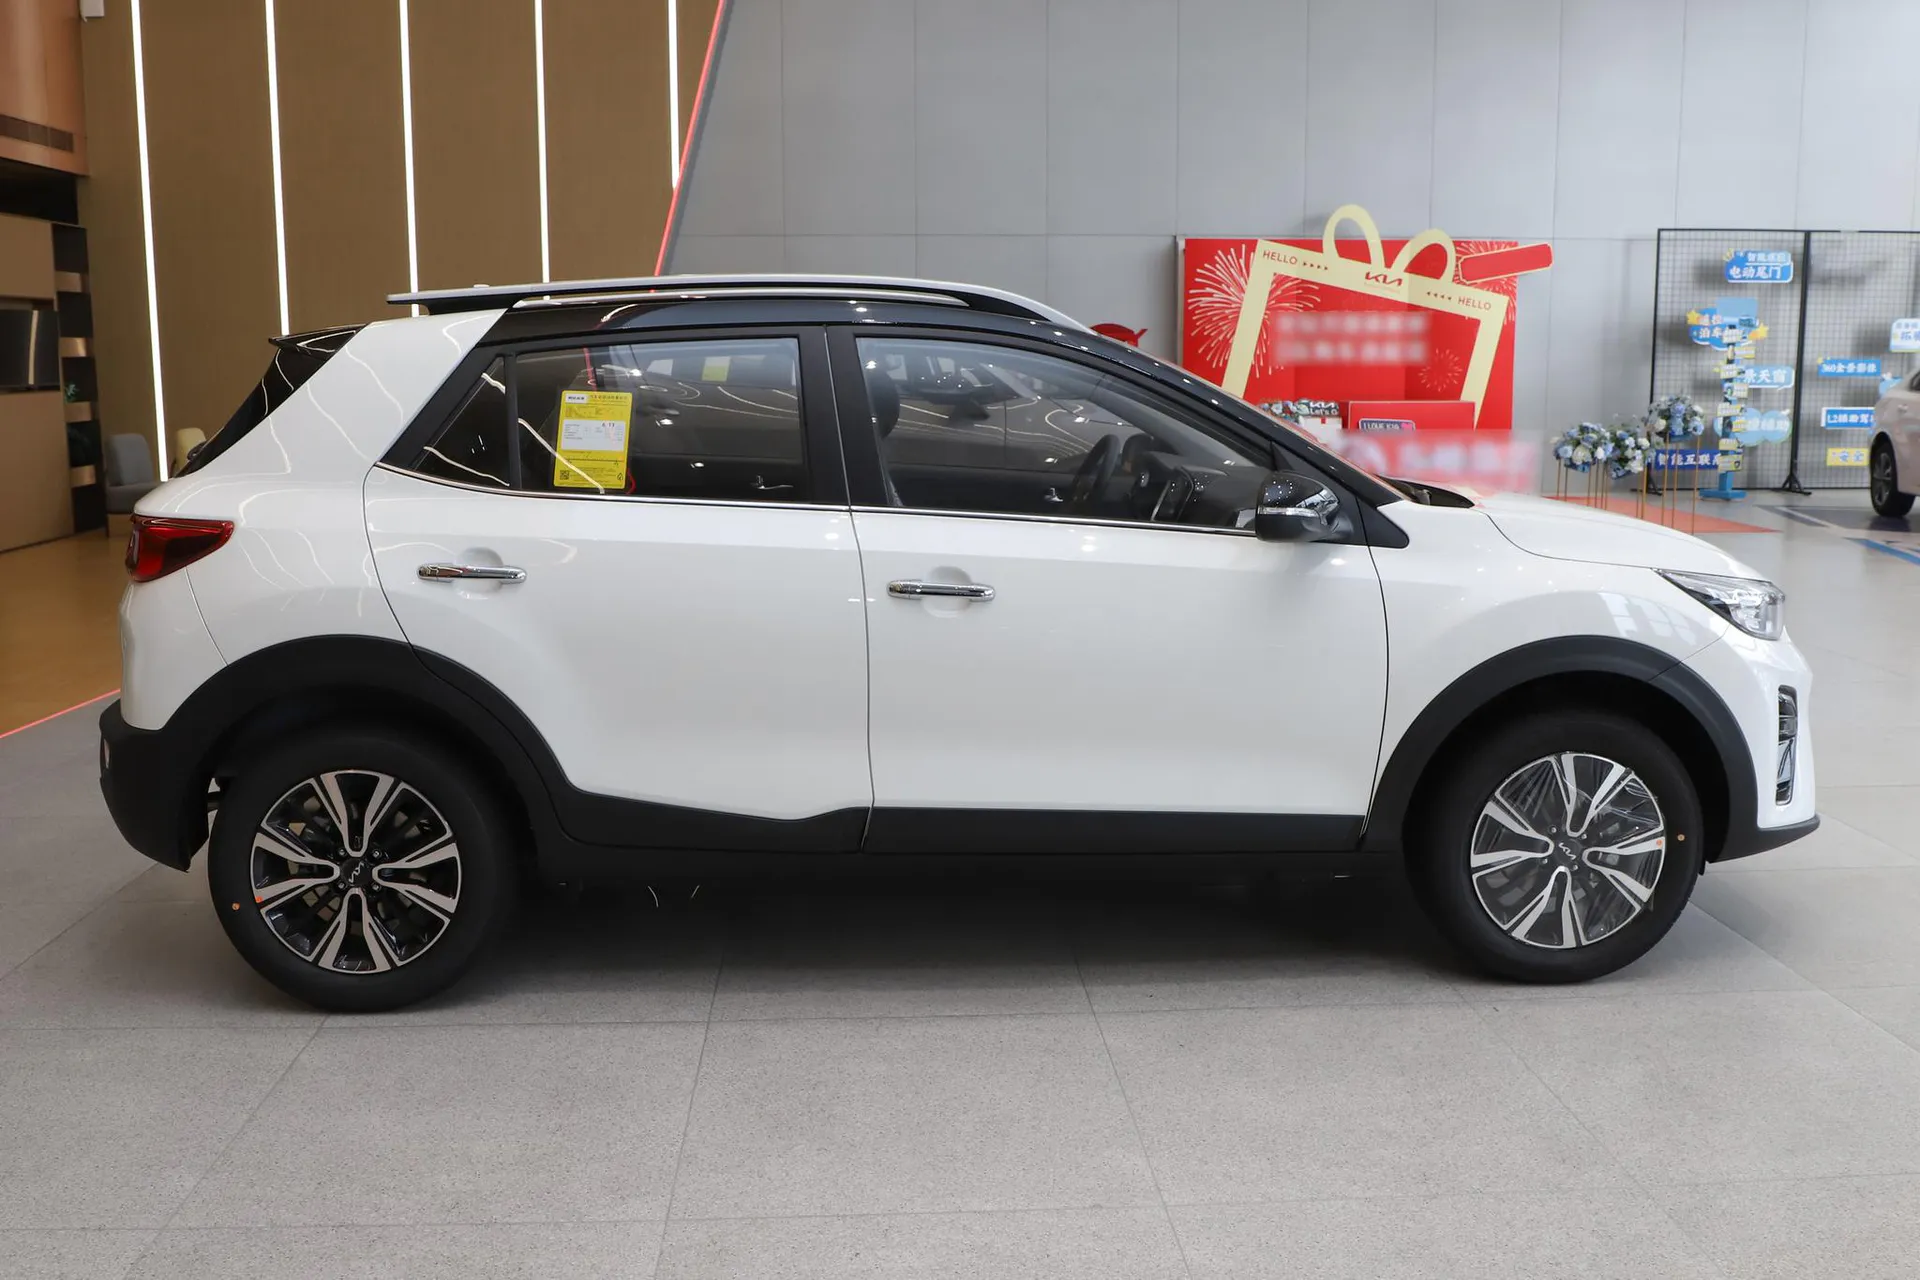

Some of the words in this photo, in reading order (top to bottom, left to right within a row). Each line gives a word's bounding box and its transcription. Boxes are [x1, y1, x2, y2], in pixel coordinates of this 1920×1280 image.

[1262, 250, 1298, 265] HELLO
[1364, 271, 1403, 287] KIA
[1729, 266, 1781, 279] 电动尾门
[1458, 295, 1492, 311] HELLO
